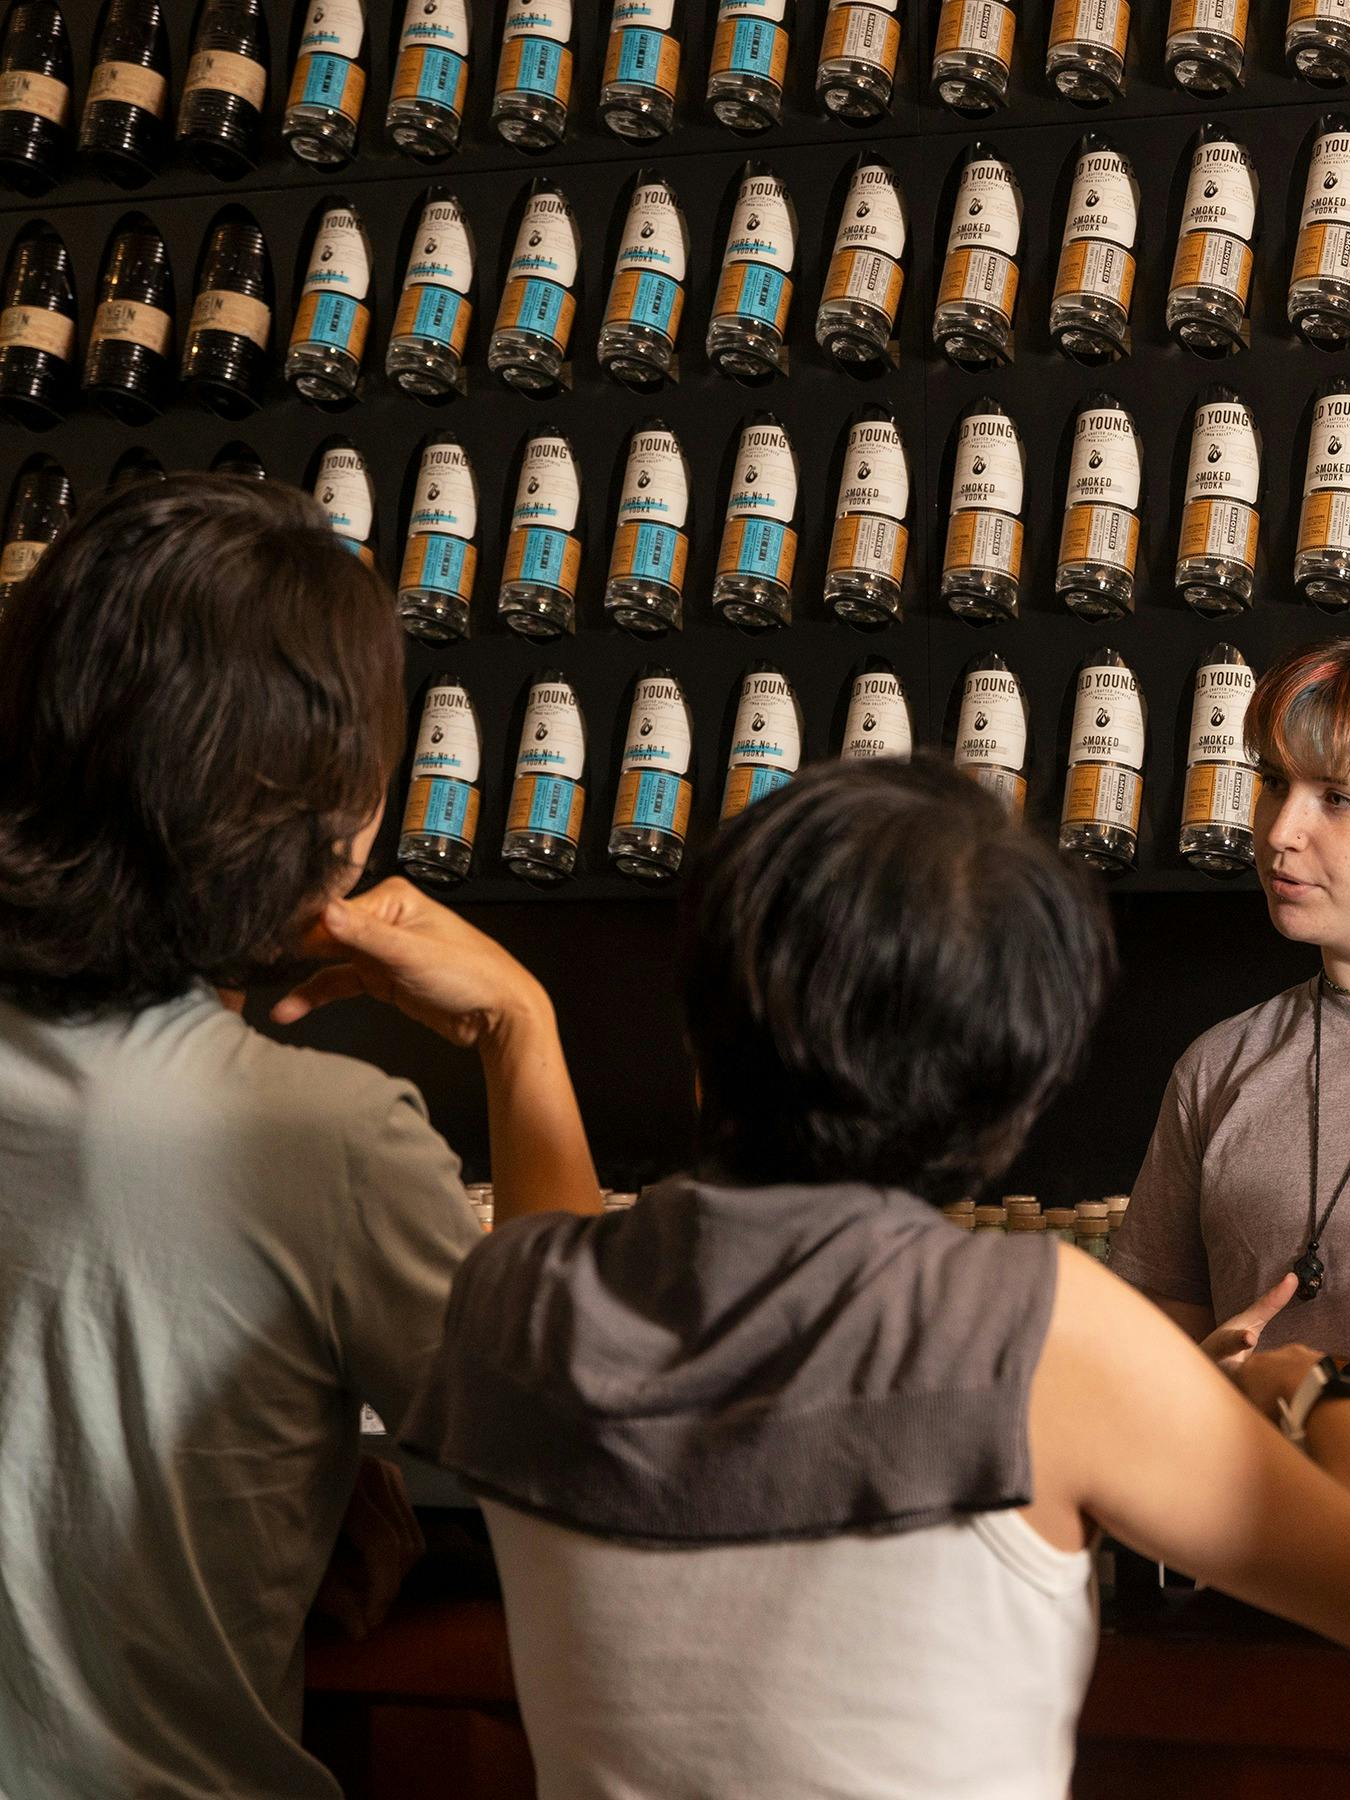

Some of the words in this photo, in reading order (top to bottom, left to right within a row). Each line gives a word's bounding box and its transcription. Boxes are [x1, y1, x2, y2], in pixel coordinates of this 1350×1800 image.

[1311, 197, 1346, 208] SMOKED
[1191, 206, 1226, 216] SMOKED
[1073, 215, 1107, 226] SMOKED
[1195, 215, 1217, 223] VODKA
[843, 225, 876, 235] SMOKED
[956, 223, 990, 234] SMOKED
[1077, 224, 1099, 232] VODKA
[960, 232, 982, 240] VODKA
[1315, 463, 1350, 474] SMOKED
[1195, 471, 1230, 482] SMOKED
[1320, 473, 1343, 481] VODKA
[1076, 477, 1111, 488] SMOKED
[845, 488, 878, 498] SMOKED
[960, 483, 995, 494] SMOKED
[1081, 487, 1103, 495] VODKA
[965, 493, 987, 501] VODKA
[850, 740, 884, 749] SMOKED
[962, 739, 996, 750] SMOKED
[1082, 736, 1118, 747] SMOKED
[1199, 735, 1234, 746] SMOKED
[967, 749, 988, 757] VODKA
[1088, 746, 1110, 754] VODKA
[1203, 746, 1226, 754] VODKA
